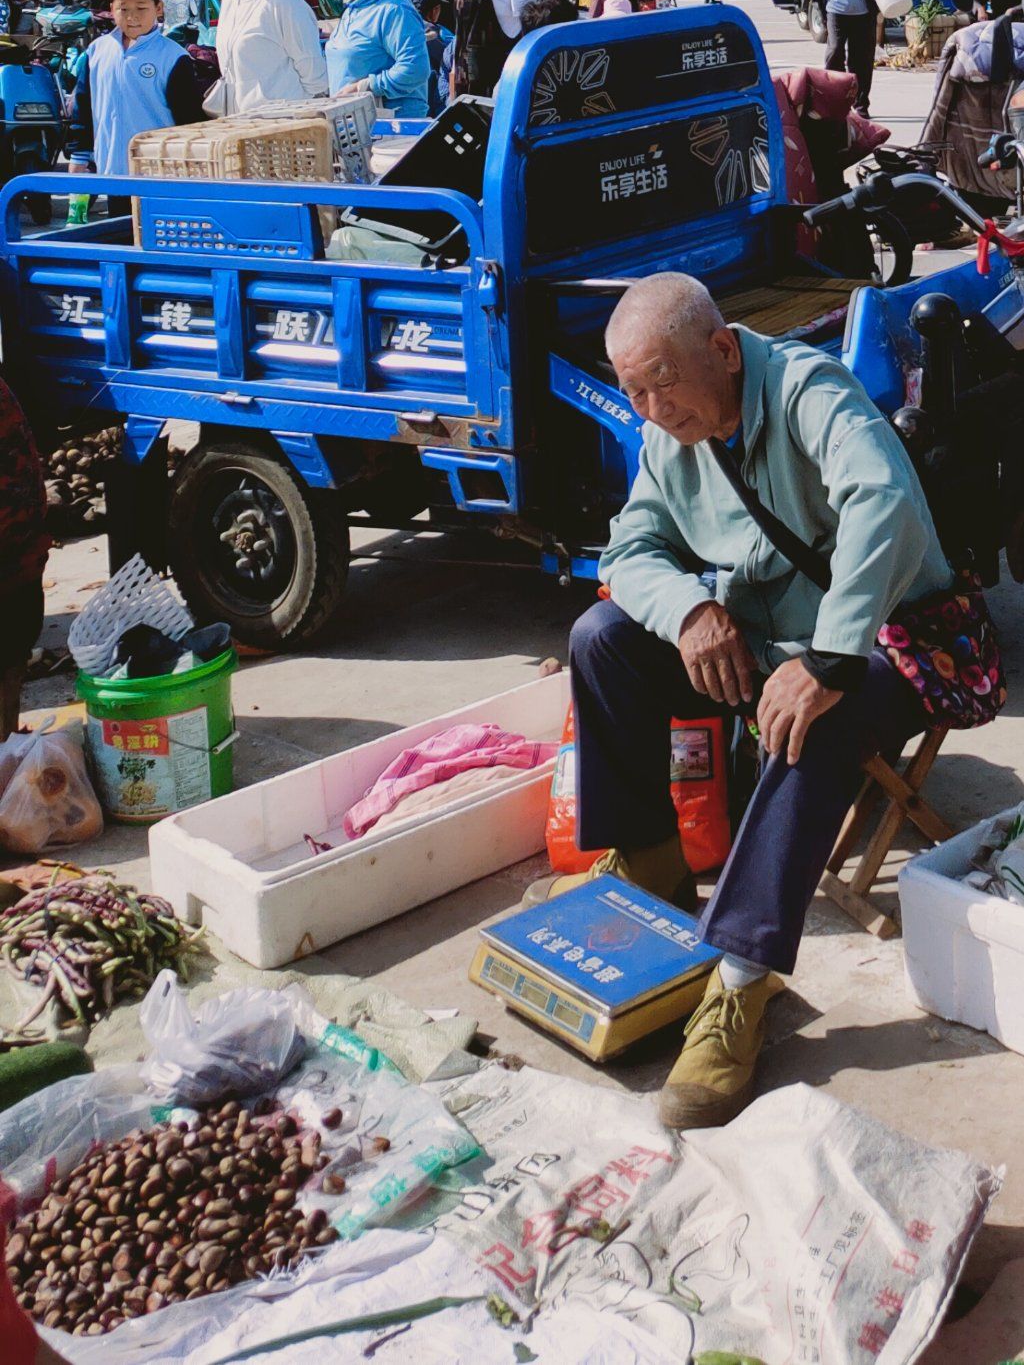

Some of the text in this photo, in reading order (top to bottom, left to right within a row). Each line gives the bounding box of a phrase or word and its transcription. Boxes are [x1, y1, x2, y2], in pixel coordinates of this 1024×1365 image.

[682, 46, 728, 71] 乐享生活
[600, 154, 646, 173] ENJOY LIFE
[601, 163, 668, 202] 乐享生活
